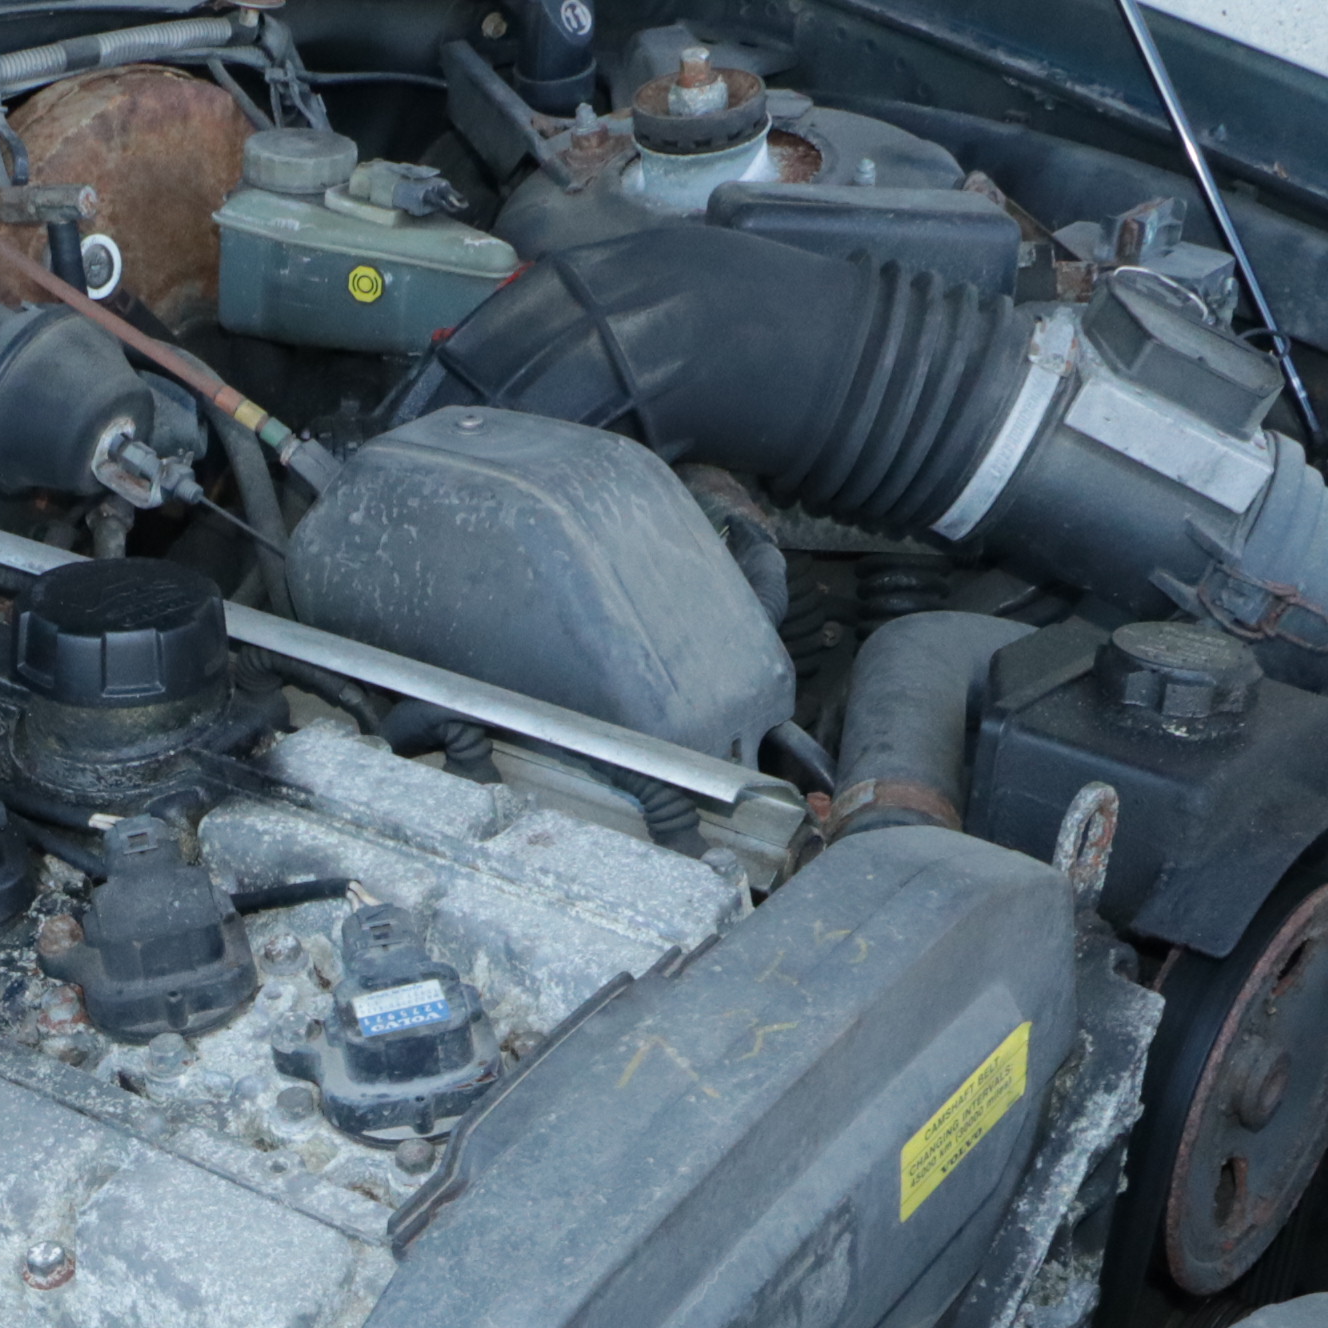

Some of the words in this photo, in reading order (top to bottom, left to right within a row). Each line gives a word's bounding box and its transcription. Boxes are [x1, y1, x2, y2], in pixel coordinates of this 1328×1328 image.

[370, 1011, 442, 1033] VOLVO
[924, 1081, 975, 1141] CAMSHAFT
[978, 1056, 1000, 1085] BELT
[909, 1119, 960, 1176] CHANGING
[940, 1127, 983, 1174] VOLVO
